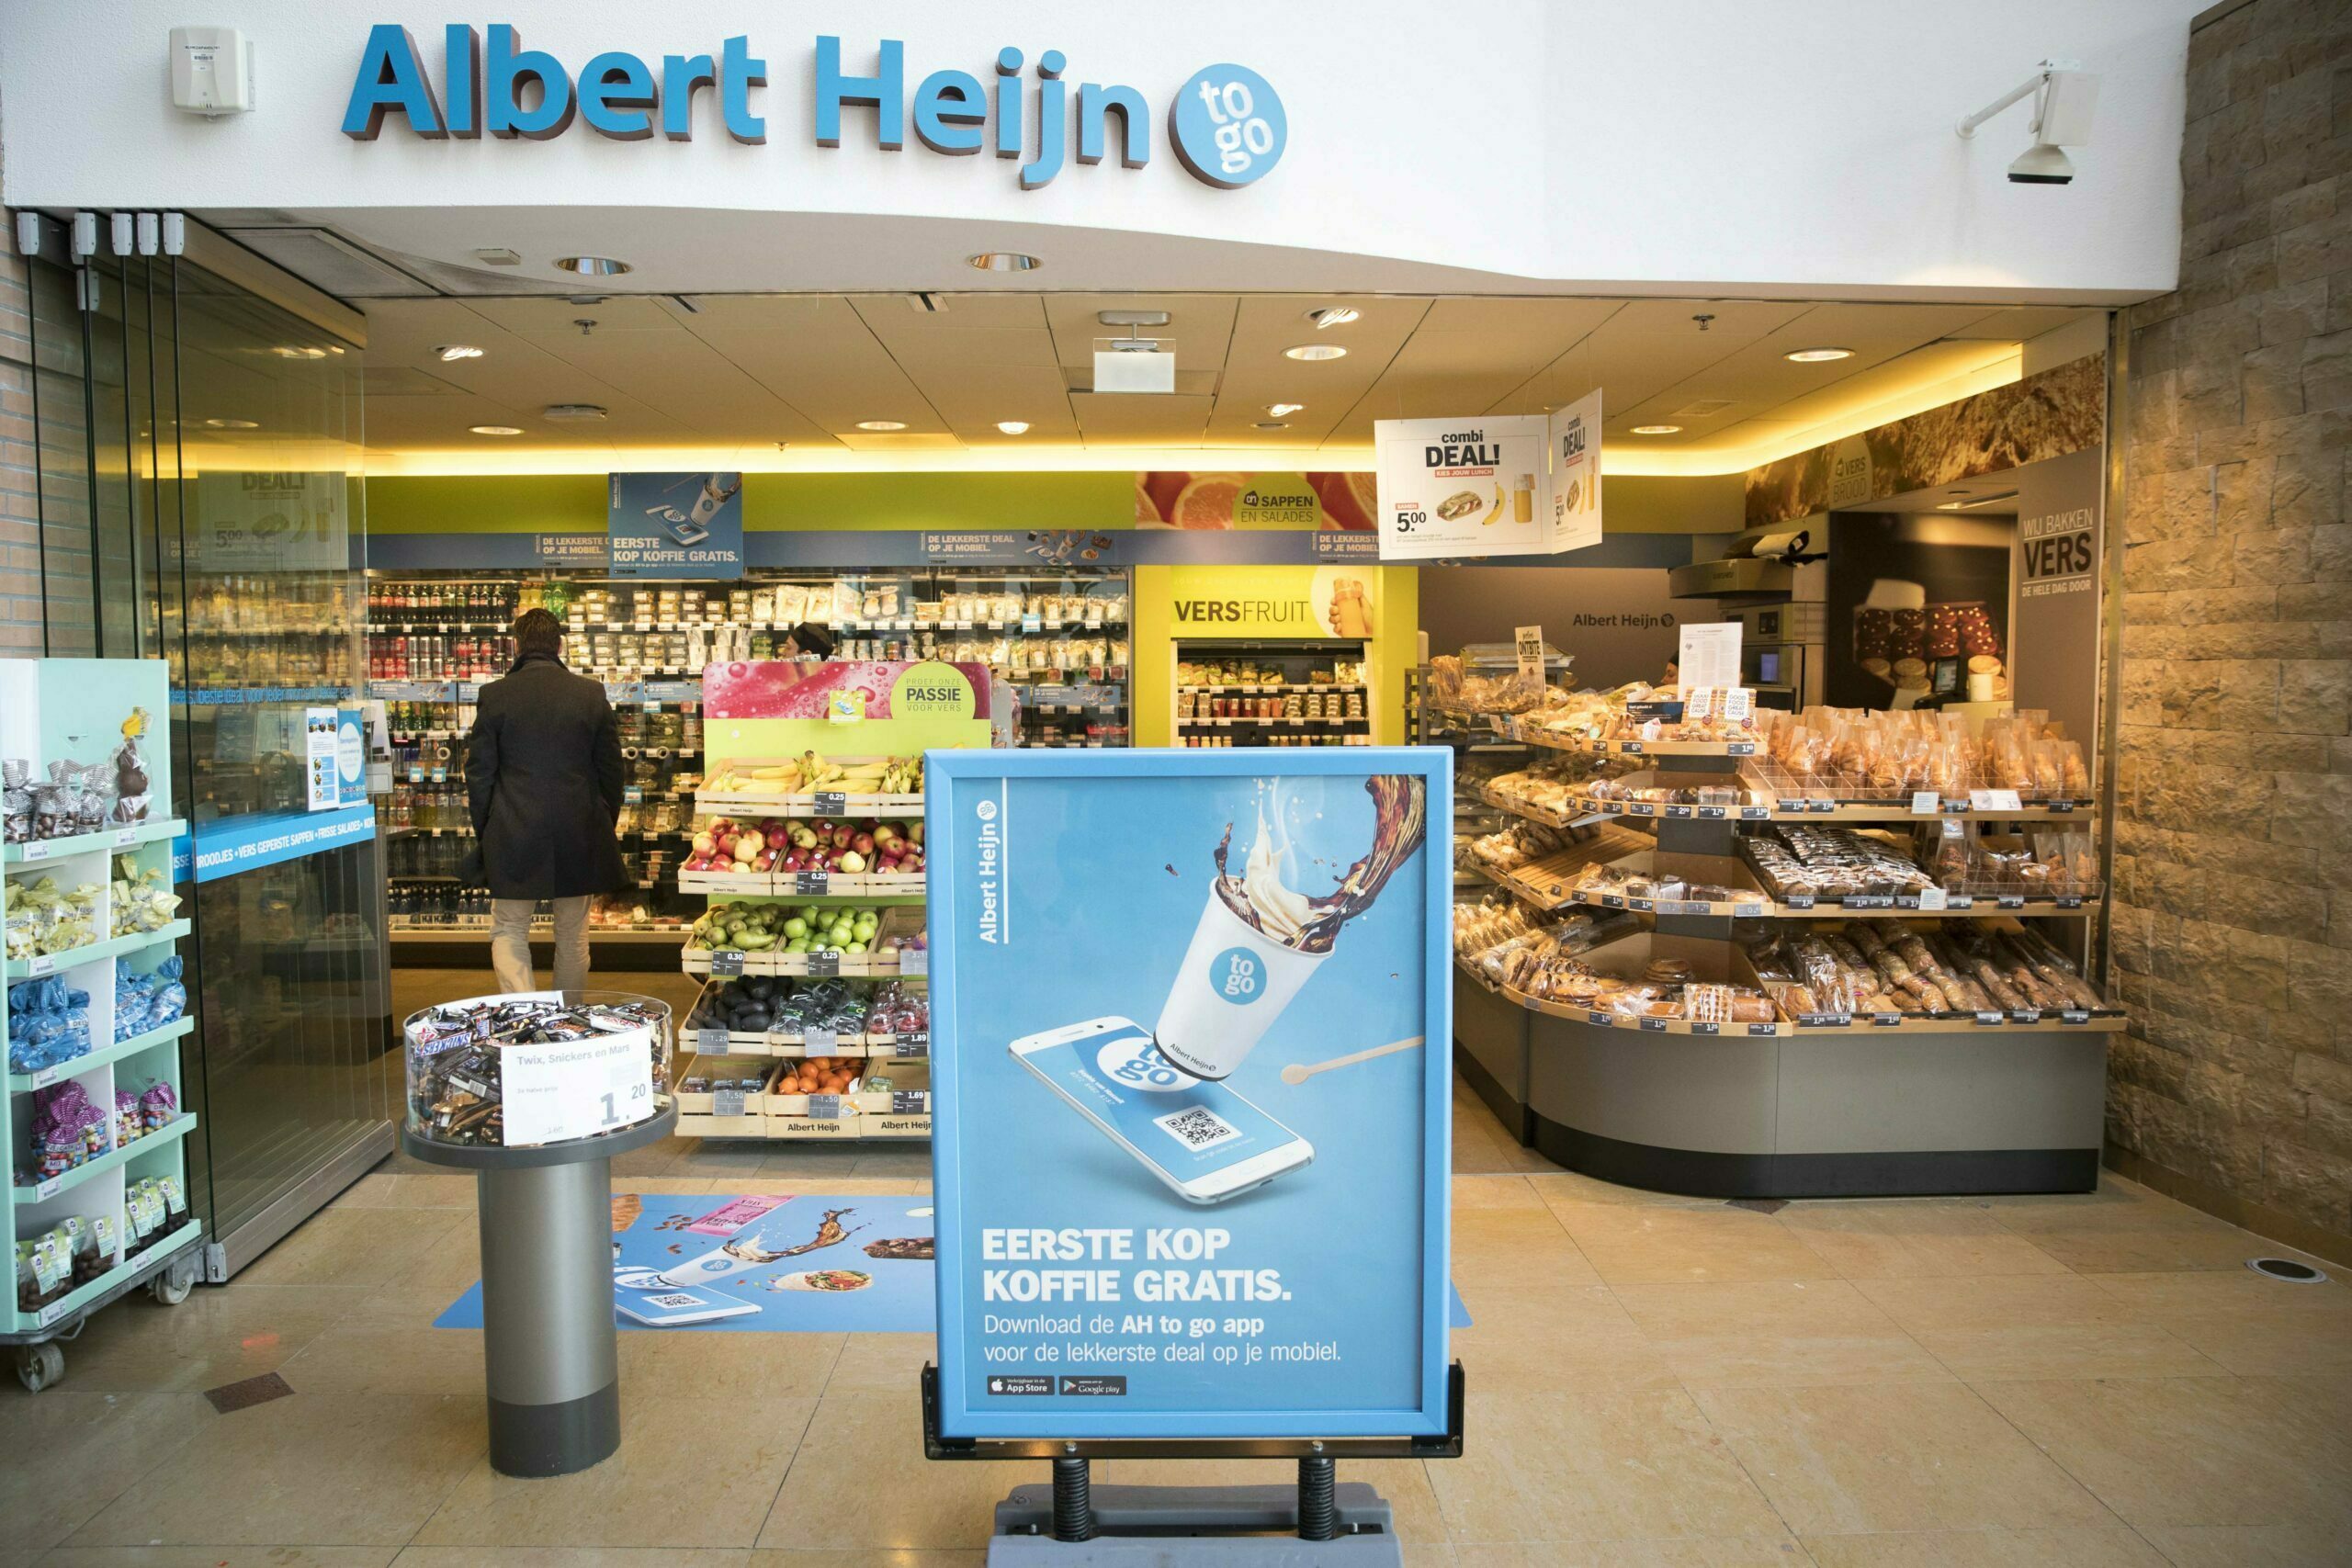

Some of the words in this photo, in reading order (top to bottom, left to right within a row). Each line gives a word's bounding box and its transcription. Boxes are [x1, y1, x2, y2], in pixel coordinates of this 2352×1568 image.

[341, 24, 767, 145] Albert
[816, 35, 1149, 190] Heijn
[1199, 79, 1255, 124] to
[1214, 117, 1274, 175] go
[1568, 412, 1581, 431] combi
[1441, 429, 1484, 444] combi
[1564, 426, 1586, 458] DEAL!
[1425, 444, 1500, 468] DEAL!
[1471, 468, 1493, 476] LUNCH
[1845, 457, 1866, 476] VERS
[1833, 477, 1866, 502] BROOD
[1261, 495, 1314, 507] SAPPEN
[1240, 511, 1257, 523] EN
[1261, 511, 1314, 523] SALADES
[2023, 517, 2042, 537] WIJ
[2046, 507, 2094, 534] BAKKEN
[542, 536, 554, 546] DE
[556, 536, 604, 546] LEKKERSTE
[613, 537, 660, 549] EERSTE
[928, 535, 939, 543] DE
[942, 535, 990, 543] LEKKERSTE
[992, 535, 1015, 543] DEAL
[1319, 535, 1331, 544] DE
[1319, 543, 1332, 552] OP
[1334, 543, 1345, 552] JE
[542, 546, 555, 554] OP
[557, 546, 568, 554] JE
[569, 546, 605, 554] MOBIEL.
[613, 550, 640, 561] KOP
[642, 550, 685, 561] KOFFIE
[689, 550, 740, 561] GRATIS.
[928, 544, 941, 552] OP
[943, 544, 954, 552] JE
[956, 544, 991, 552] MOBIEL.
[2023, 532, 2092, 578] VERS
[2021, 587, 2031, 597] DE
[2032, 584, 2051, 596] HELE
[2052, 582, 2067, 594] DAG
[2068, 580, 2092, 592] DOOR
[1174, 600, 1309, 622] VERSFRUIT
[1573, 613, 1618, 626] Albert
[1621, 613, 1658, 630] Heijn
[906, 687, 961, 701] PASSIE
[906, 704, 933, 712] VOOR
[936, 704, 962, 712] VERS
[828, 792, 845, 801] 0.25
[238, 842, 257, 859] VERS
[257, 836, 290, 855] GEPERSTE
[290, 830, 314, 846] SAPPEN
[978, 823, 1001, 876] Heijn
[811, 872, 827, 880] 0.25
[979, 881, 998, 944] Albert
[727, 953, 743, 961] 0.30
[821, 951, 838, 960] 0.25
[1230, 953, 1254, 976] to
[1225, 973, 1256, 996] go
[910, 1032, 927, 1043] 1.89
[516, 1055, 546, 1066] Twix,
[548, 1052, 593, 1065] Snickers
[608, 1043, 630, 1056] Mars
[1170, 1043, 1191, 1059] Albert
[1190, 1055, 1209, 1070] Heijn
[1114, 1059, 1178, 1086] go
[908, 1091, 924, 1100] 1.69
[786, 1122, 815, 1132] Albert
[817, 1122, 840, 1133] Heijn
[880, 1121, 909, 1130] Albert
[982, 1228, 1134, 1260] EERSTE
[1147, 1228, 1231, 1260] KOP
[983, 1269, 1121, 1302] KOFFIE
[1133, 1269, 1293, 1303] GRATIS.
[984, 1314, 1081, 1334] Download
[1089, 1314, 1114, 1334] de
[1120, 1314, 1153, 1334] AH
[1159, 1316, 1182, 1334] to
[1188, 1319, 1216, 1337] go
[1222, 1319, 1265, 1337] app
[984, 1346, 1028, 1362] voor
[1035, 1341, 1059, 1362] de
[1067, 1341, 1157, 1362] lekkerste
[1163, 1341, 1205, 1362] deal
[1213, 1346, 1238, 1366] op
[1244, 1341, 1262, 1366] je
[1270, 1341, 1341, 1361] mobiel.
[1007, 1384, 1024, 1393] App
[1025, 1384, 1047, 1393] Store
[1078, 1384, 1104, 1394] Google
[1105, 1385, 1120, 1394] play
